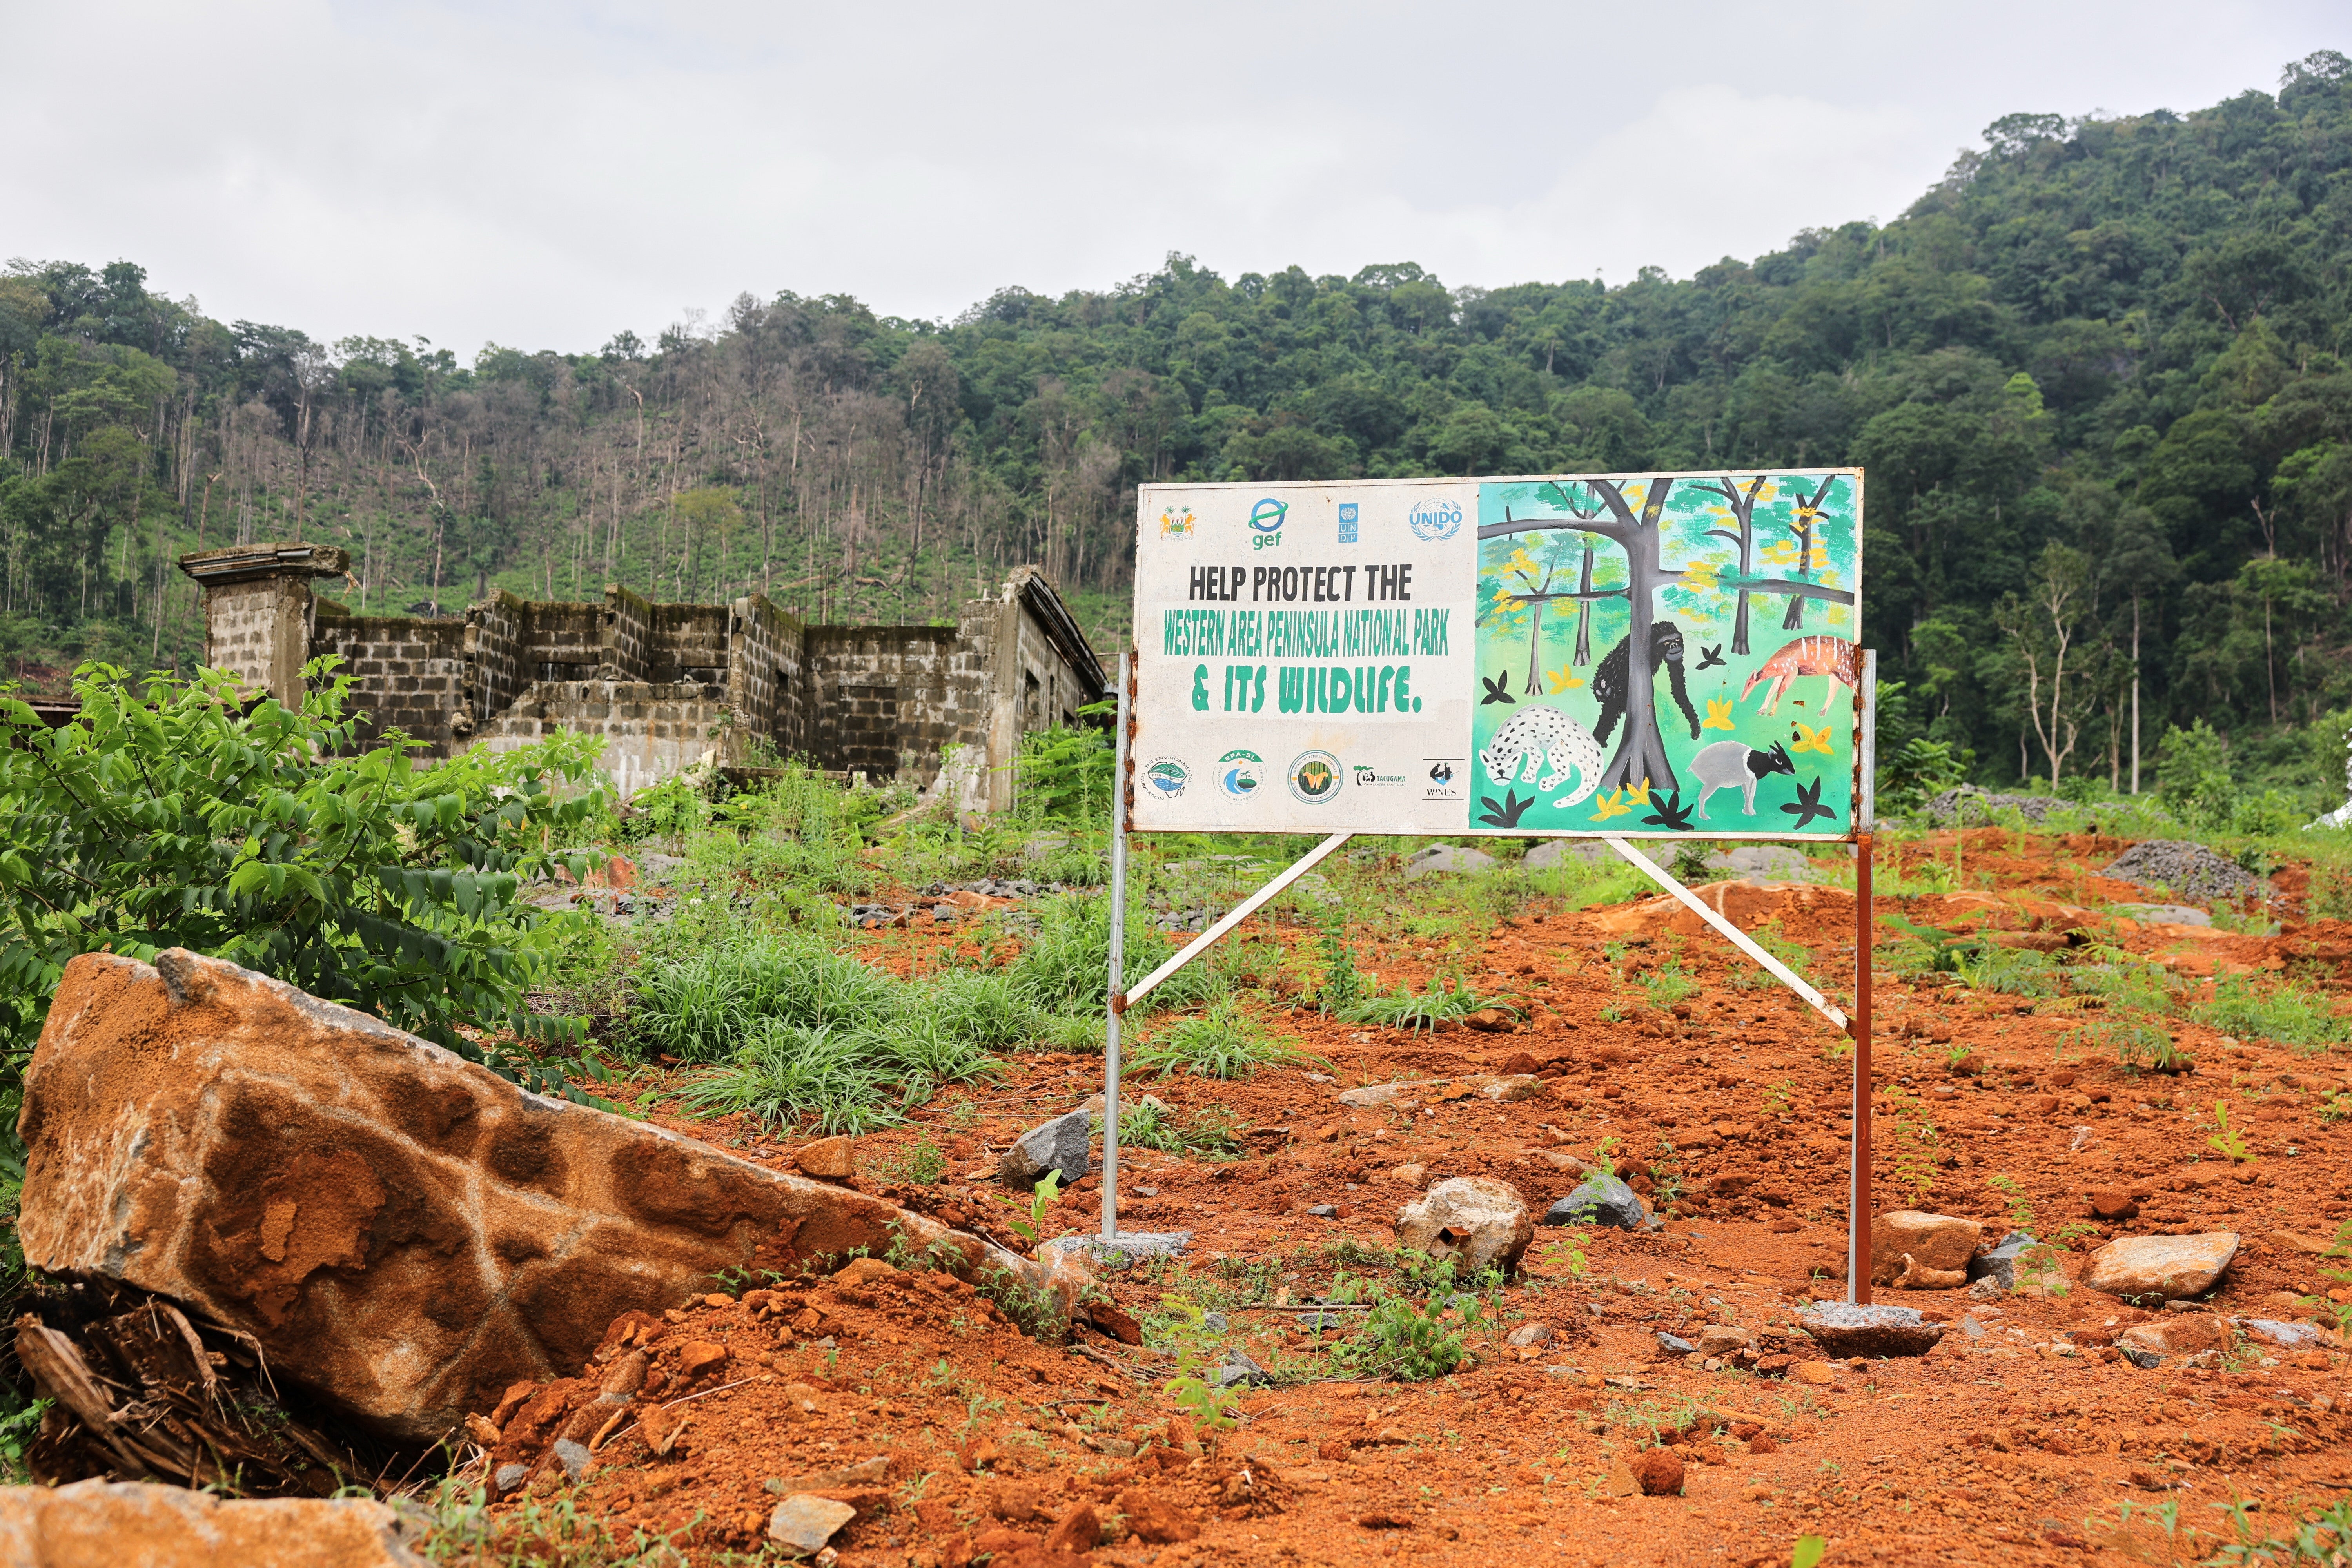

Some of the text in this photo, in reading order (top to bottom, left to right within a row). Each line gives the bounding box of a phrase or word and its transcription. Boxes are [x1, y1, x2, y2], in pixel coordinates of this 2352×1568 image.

[1409, 511, 1463, 525] UNIDO
[1252, 531, 1282, 550] gef
[1189, 564, 1412, 602] HELP PROTECT THE
[1164, 608, 1450, 658] WESTERN AREA PENINSULA NATIONAL PARK
[1192, 664, 1422, 714] & ITS WILDLIFE.
[1144, 756, 1192, 783] THE ENVIRONMENTAL
[1225, 752, 1255, 761] EPA-SL
[1293, 761, 1302, 774] NATIONAL
[1140, 773, 1164, 800] FOUNDATION
[1217, 767, 1231, 799] ENVIRONMENT
[1232, 787, 1261, 801] PROTECTION
